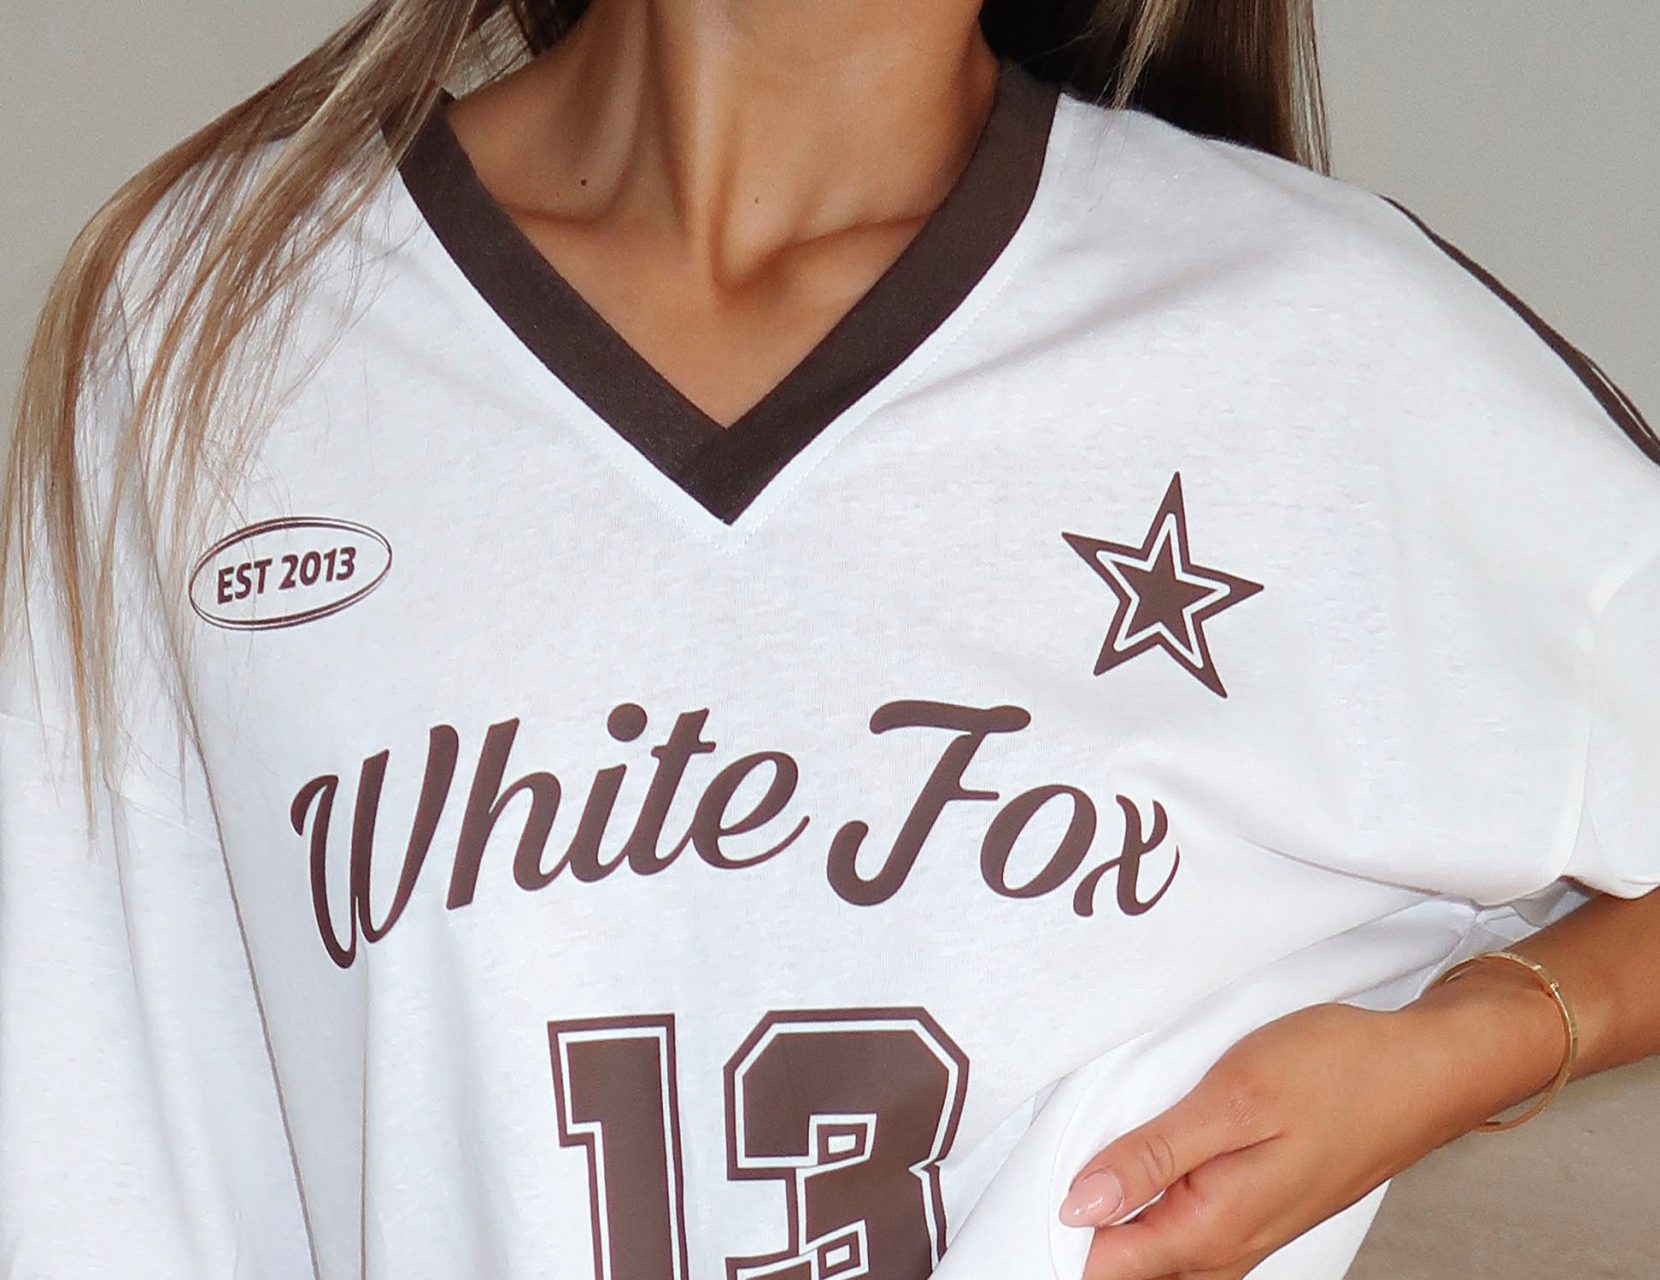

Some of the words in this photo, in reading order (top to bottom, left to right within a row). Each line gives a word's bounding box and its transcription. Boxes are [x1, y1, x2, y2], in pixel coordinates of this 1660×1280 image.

[216, 558, 273, 605] EST
[278, 546, 357, 590] 2013
[290, 703, 811, 970] White
[826, 699, 1180, 917] Fox
